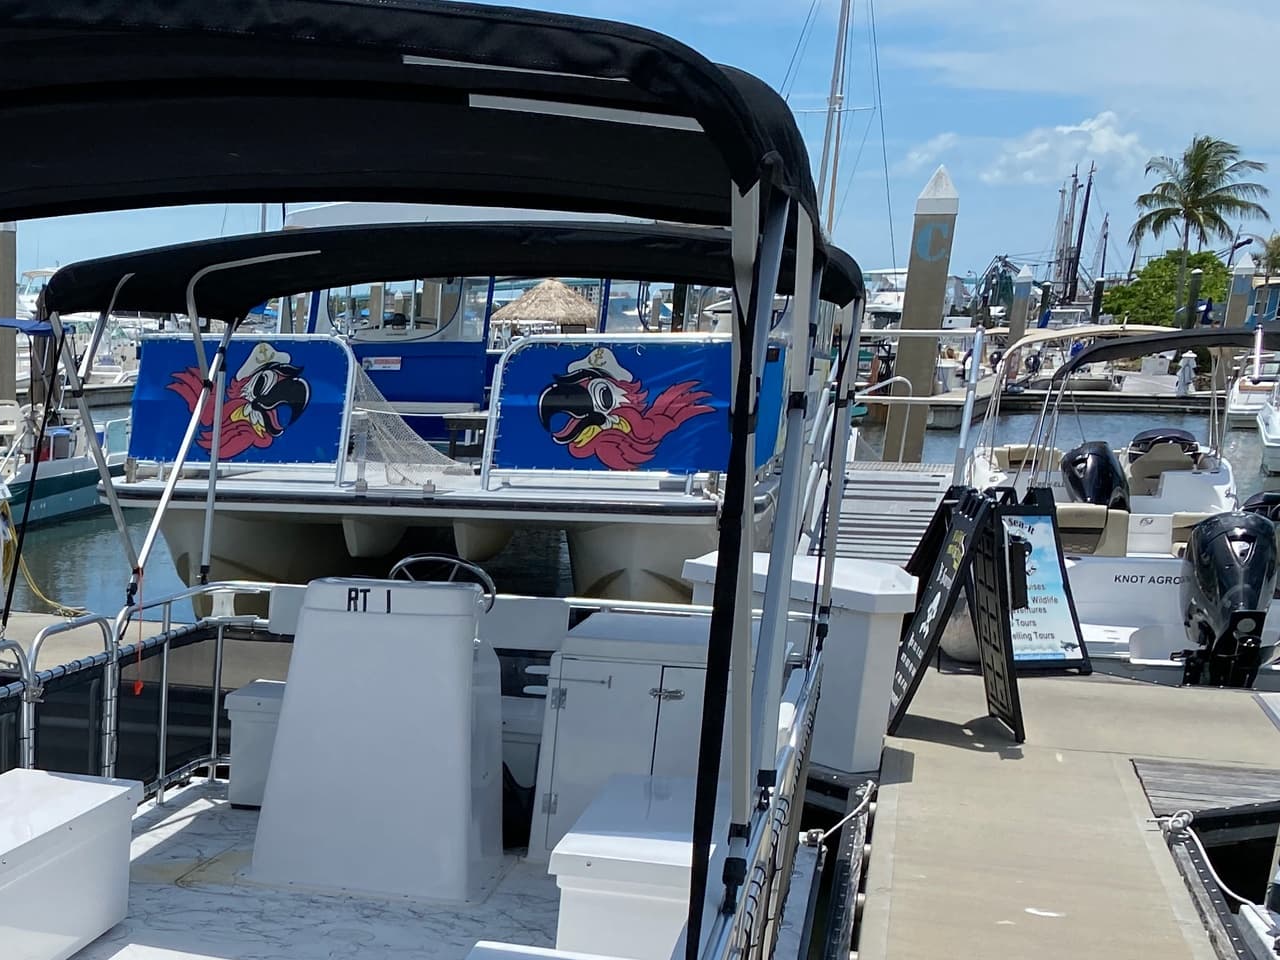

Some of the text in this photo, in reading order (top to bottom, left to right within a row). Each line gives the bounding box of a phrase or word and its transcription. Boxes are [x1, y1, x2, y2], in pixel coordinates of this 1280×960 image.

[916, 223, 949, 261] C
[1114, 574, 1146, 584] KNOT
[347, 587, 371, 613] RT
[1015, 618, 1038, 627] Tours
[1033, 631, 1055, 640] Tours
